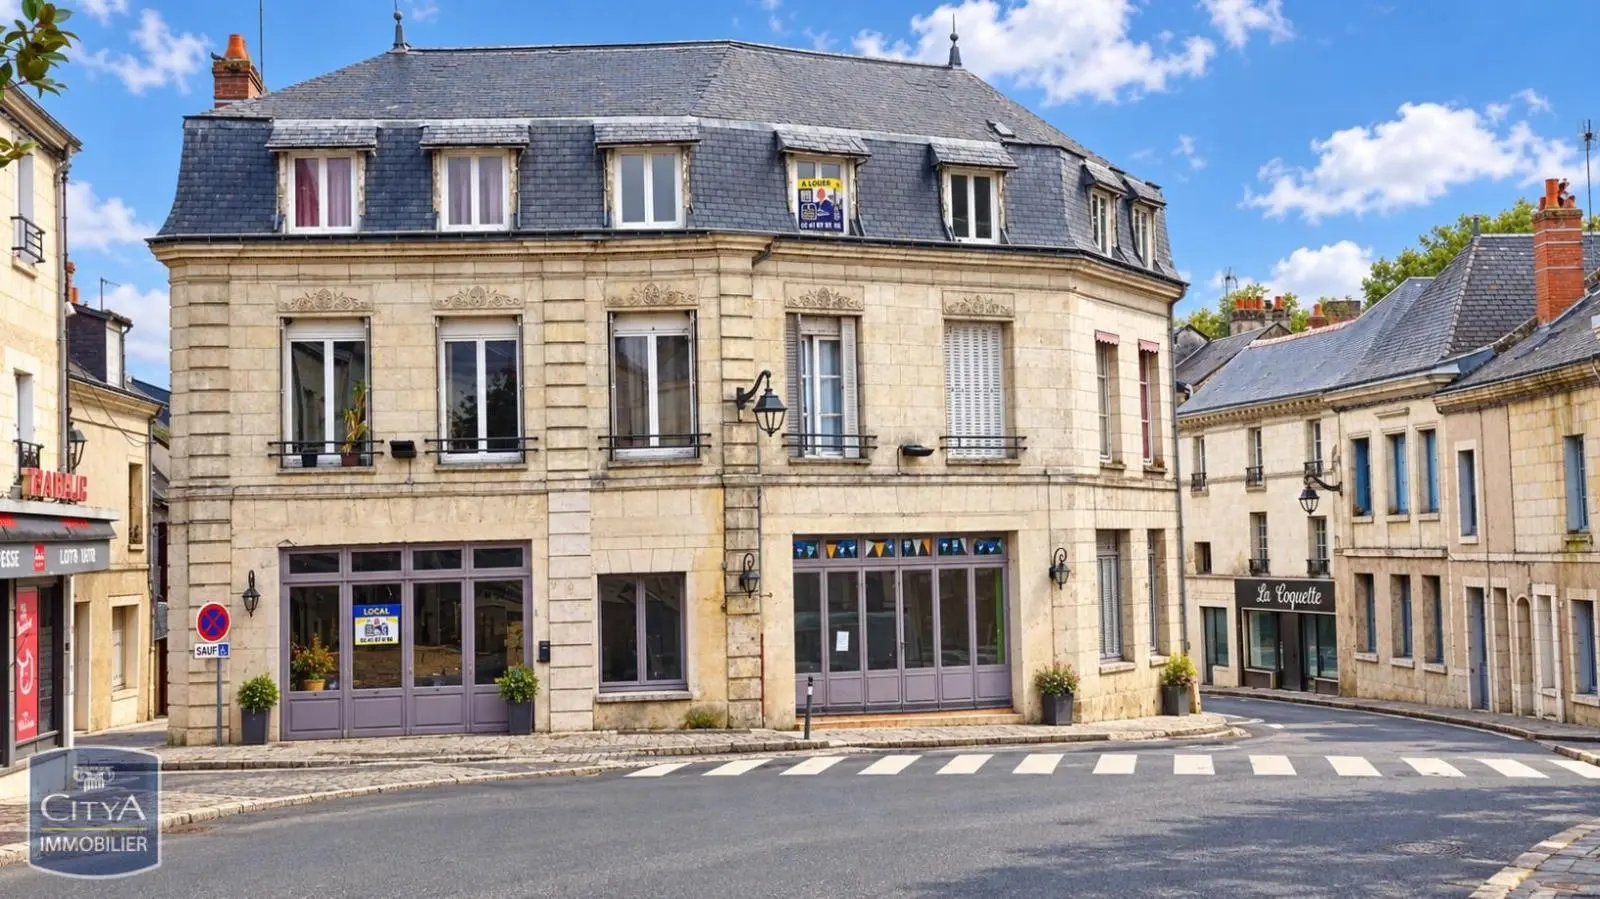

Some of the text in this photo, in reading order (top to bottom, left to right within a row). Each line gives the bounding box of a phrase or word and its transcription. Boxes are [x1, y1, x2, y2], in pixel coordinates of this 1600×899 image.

[0, 549, 21, 568] ESSE
[1256, 583, 1322, 610] La Coquette
[363, 607, 391, 616] LOCAL
[196, 645, 218, 656] SAUF
